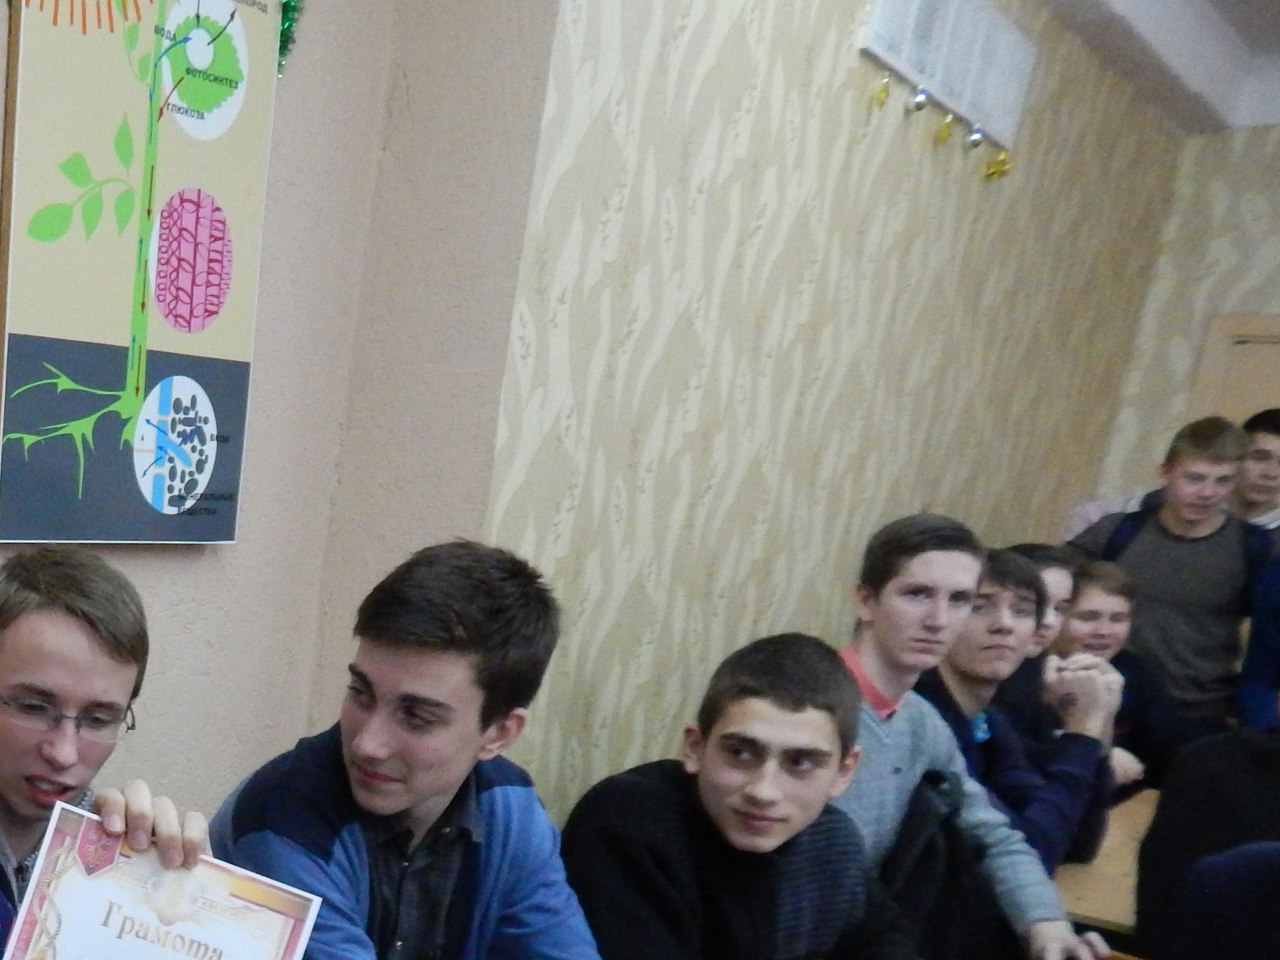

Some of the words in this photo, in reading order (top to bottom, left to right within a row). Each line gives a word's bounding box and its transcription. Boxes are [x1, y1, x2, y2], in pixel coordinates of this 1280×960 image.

[154, 24, 177, 42] ВОДА
[185, 67, 238, 90] ФОТОСИНТЕЗ
[166, 102, 205, 120] ГЛЮКОЗА
